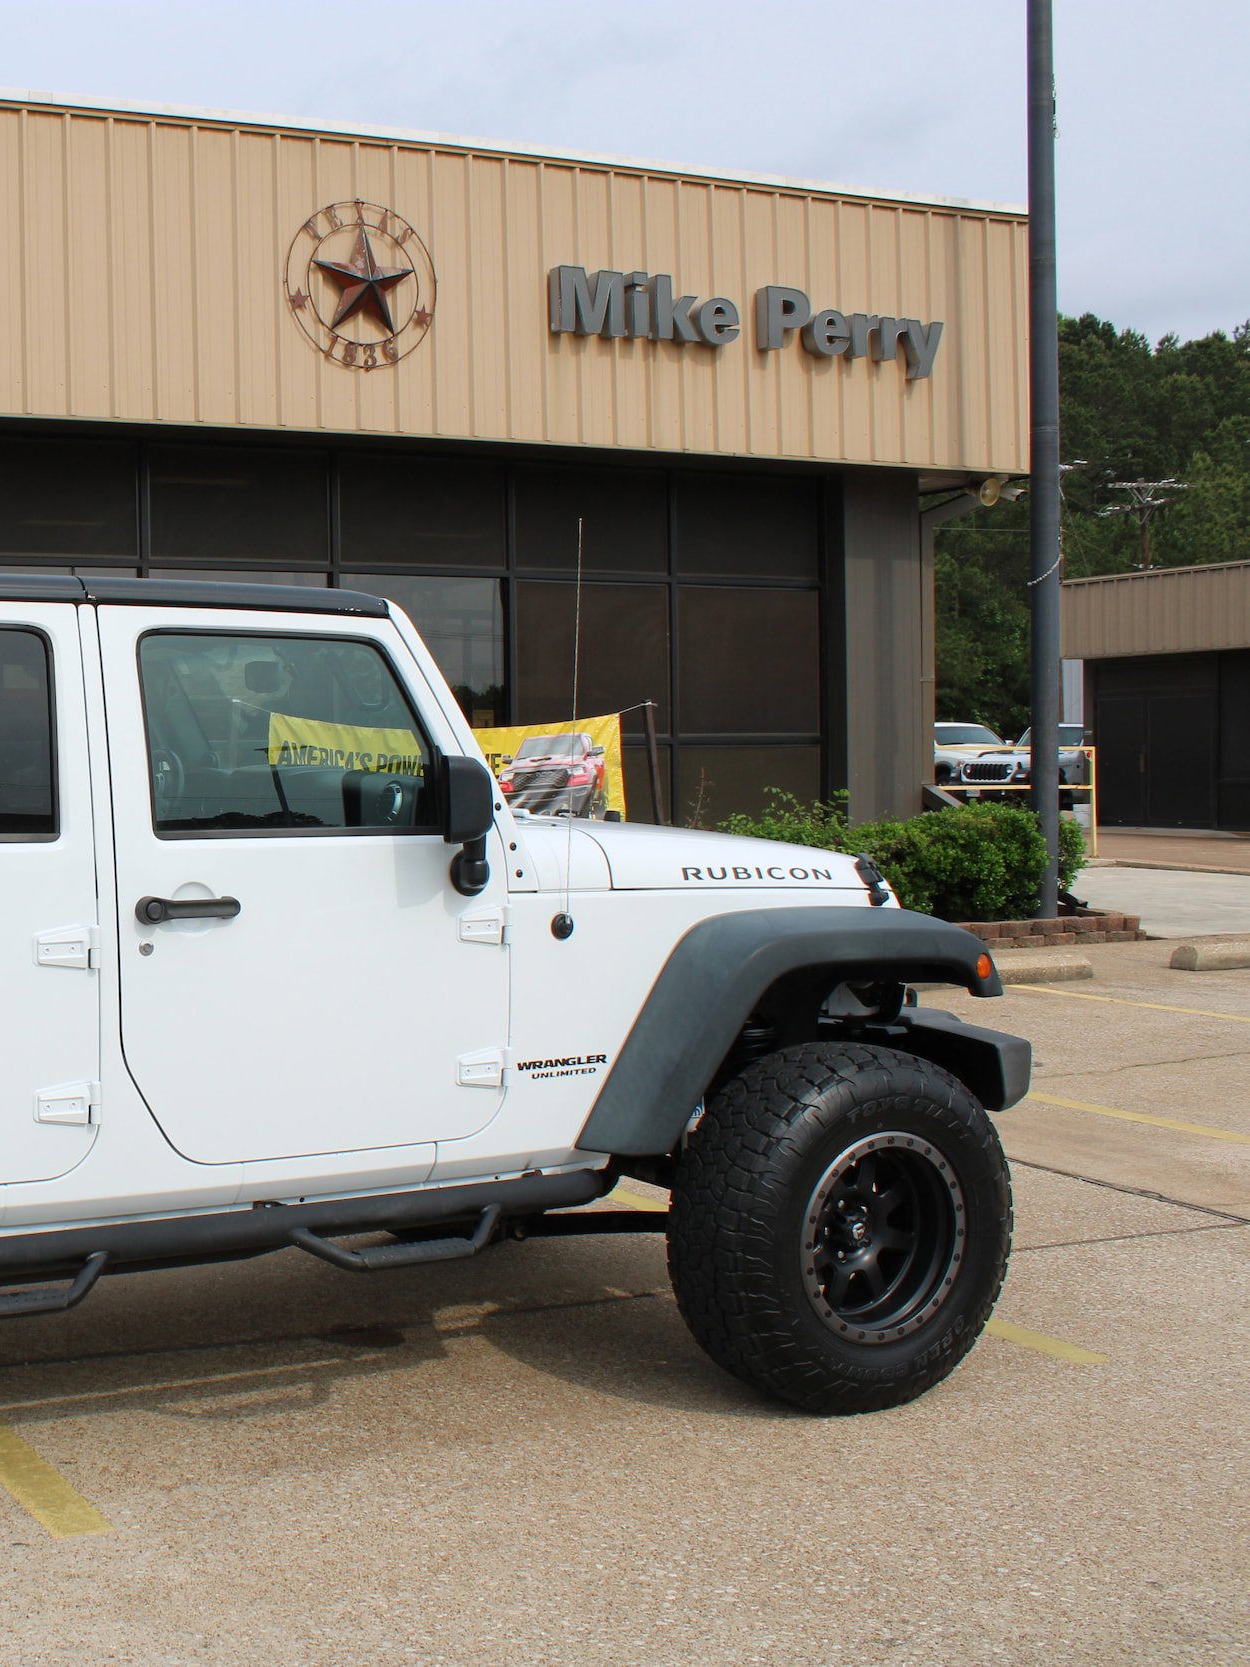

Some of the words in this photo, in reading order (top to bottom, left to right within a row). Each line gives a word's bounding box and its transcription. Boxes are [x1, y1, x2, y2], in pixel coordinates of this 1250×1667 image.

[304, 201, 414, 246] TEXAS
[549, 265, 741, 346] Mike
[756, 285, 944, 379] Perry
[325, 334, 399, 368] 1836
[681, 867, 832, 880] RUBICON
[516, 1054, 607, 1071] WRANGLER
[531, 1067, 596, 1079] UNLIMITED
